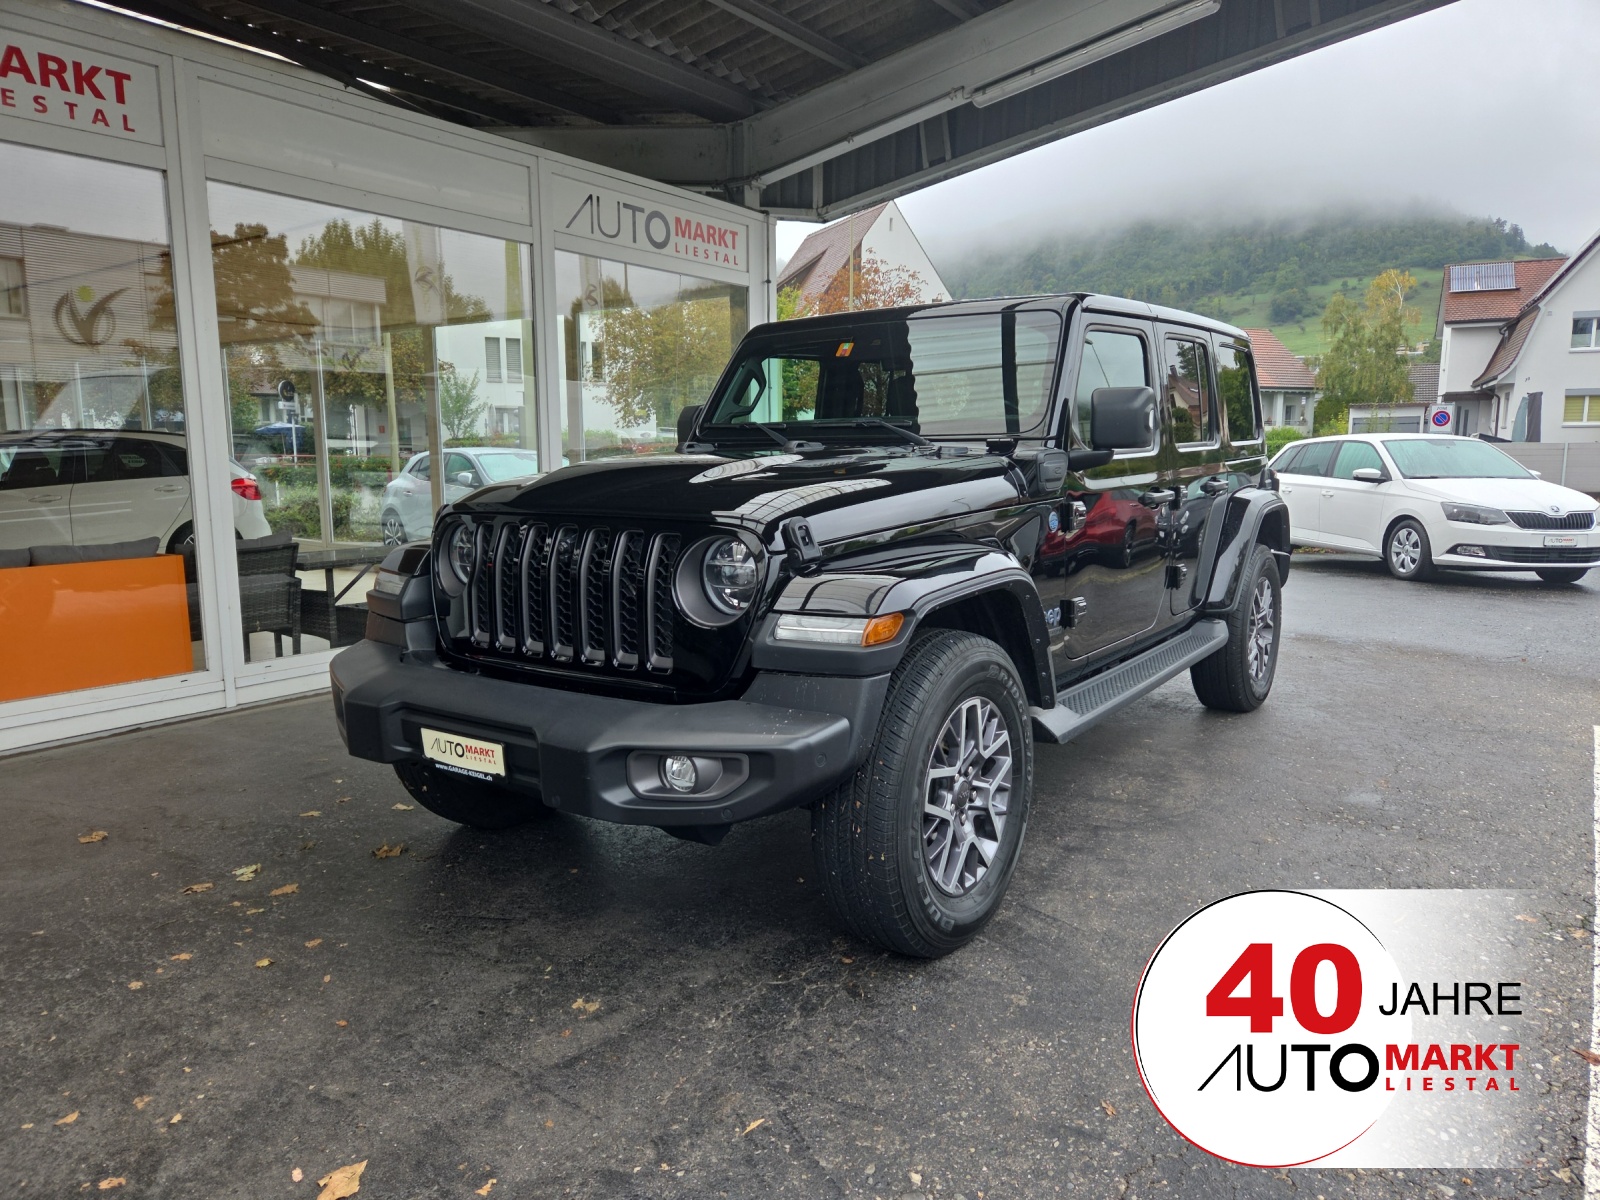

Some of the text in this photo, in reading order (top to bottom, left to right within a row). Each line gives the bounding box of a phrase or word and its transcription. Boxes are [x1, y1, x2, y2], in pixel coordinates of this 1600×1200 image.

[565, 193, 739, 250] AUTO MARKT
[674, 242, 739, 266] LIESTAL
[1043, 607, 1061, 626] ep
[430, 737, 495, 759] AUTO MARKT
[465, 754, 497, 765] LIESTAL
